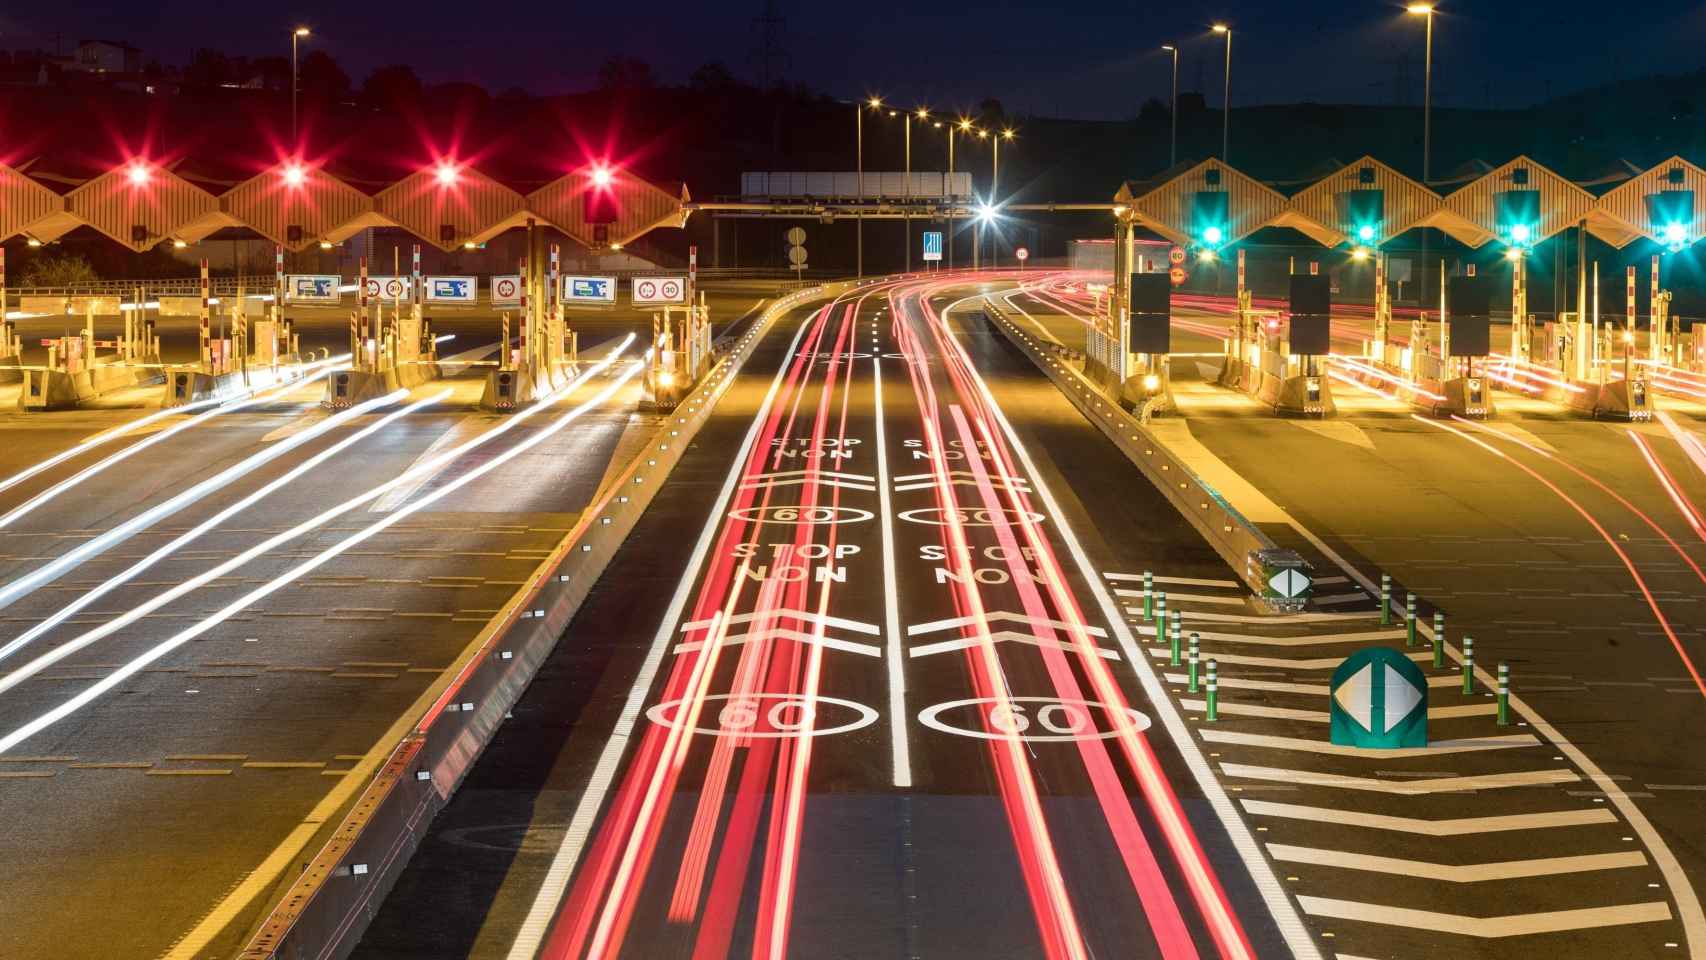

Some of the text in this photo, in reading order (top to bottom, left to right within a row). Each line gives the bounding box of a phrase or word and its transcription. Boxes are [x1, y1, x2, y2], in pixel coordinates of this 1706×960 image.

[665, 286, 676, 294] 30
[770, 438, 862, 447] STOP
[774, 449, 852, 458] NON
[773, 508, 833, 521] 60
[730, 543, 861, 559] STOP
[734, 565, 846, 582] NON
[718, 701, 816, 731] 60
[989, 704, 1087, 734] 60
